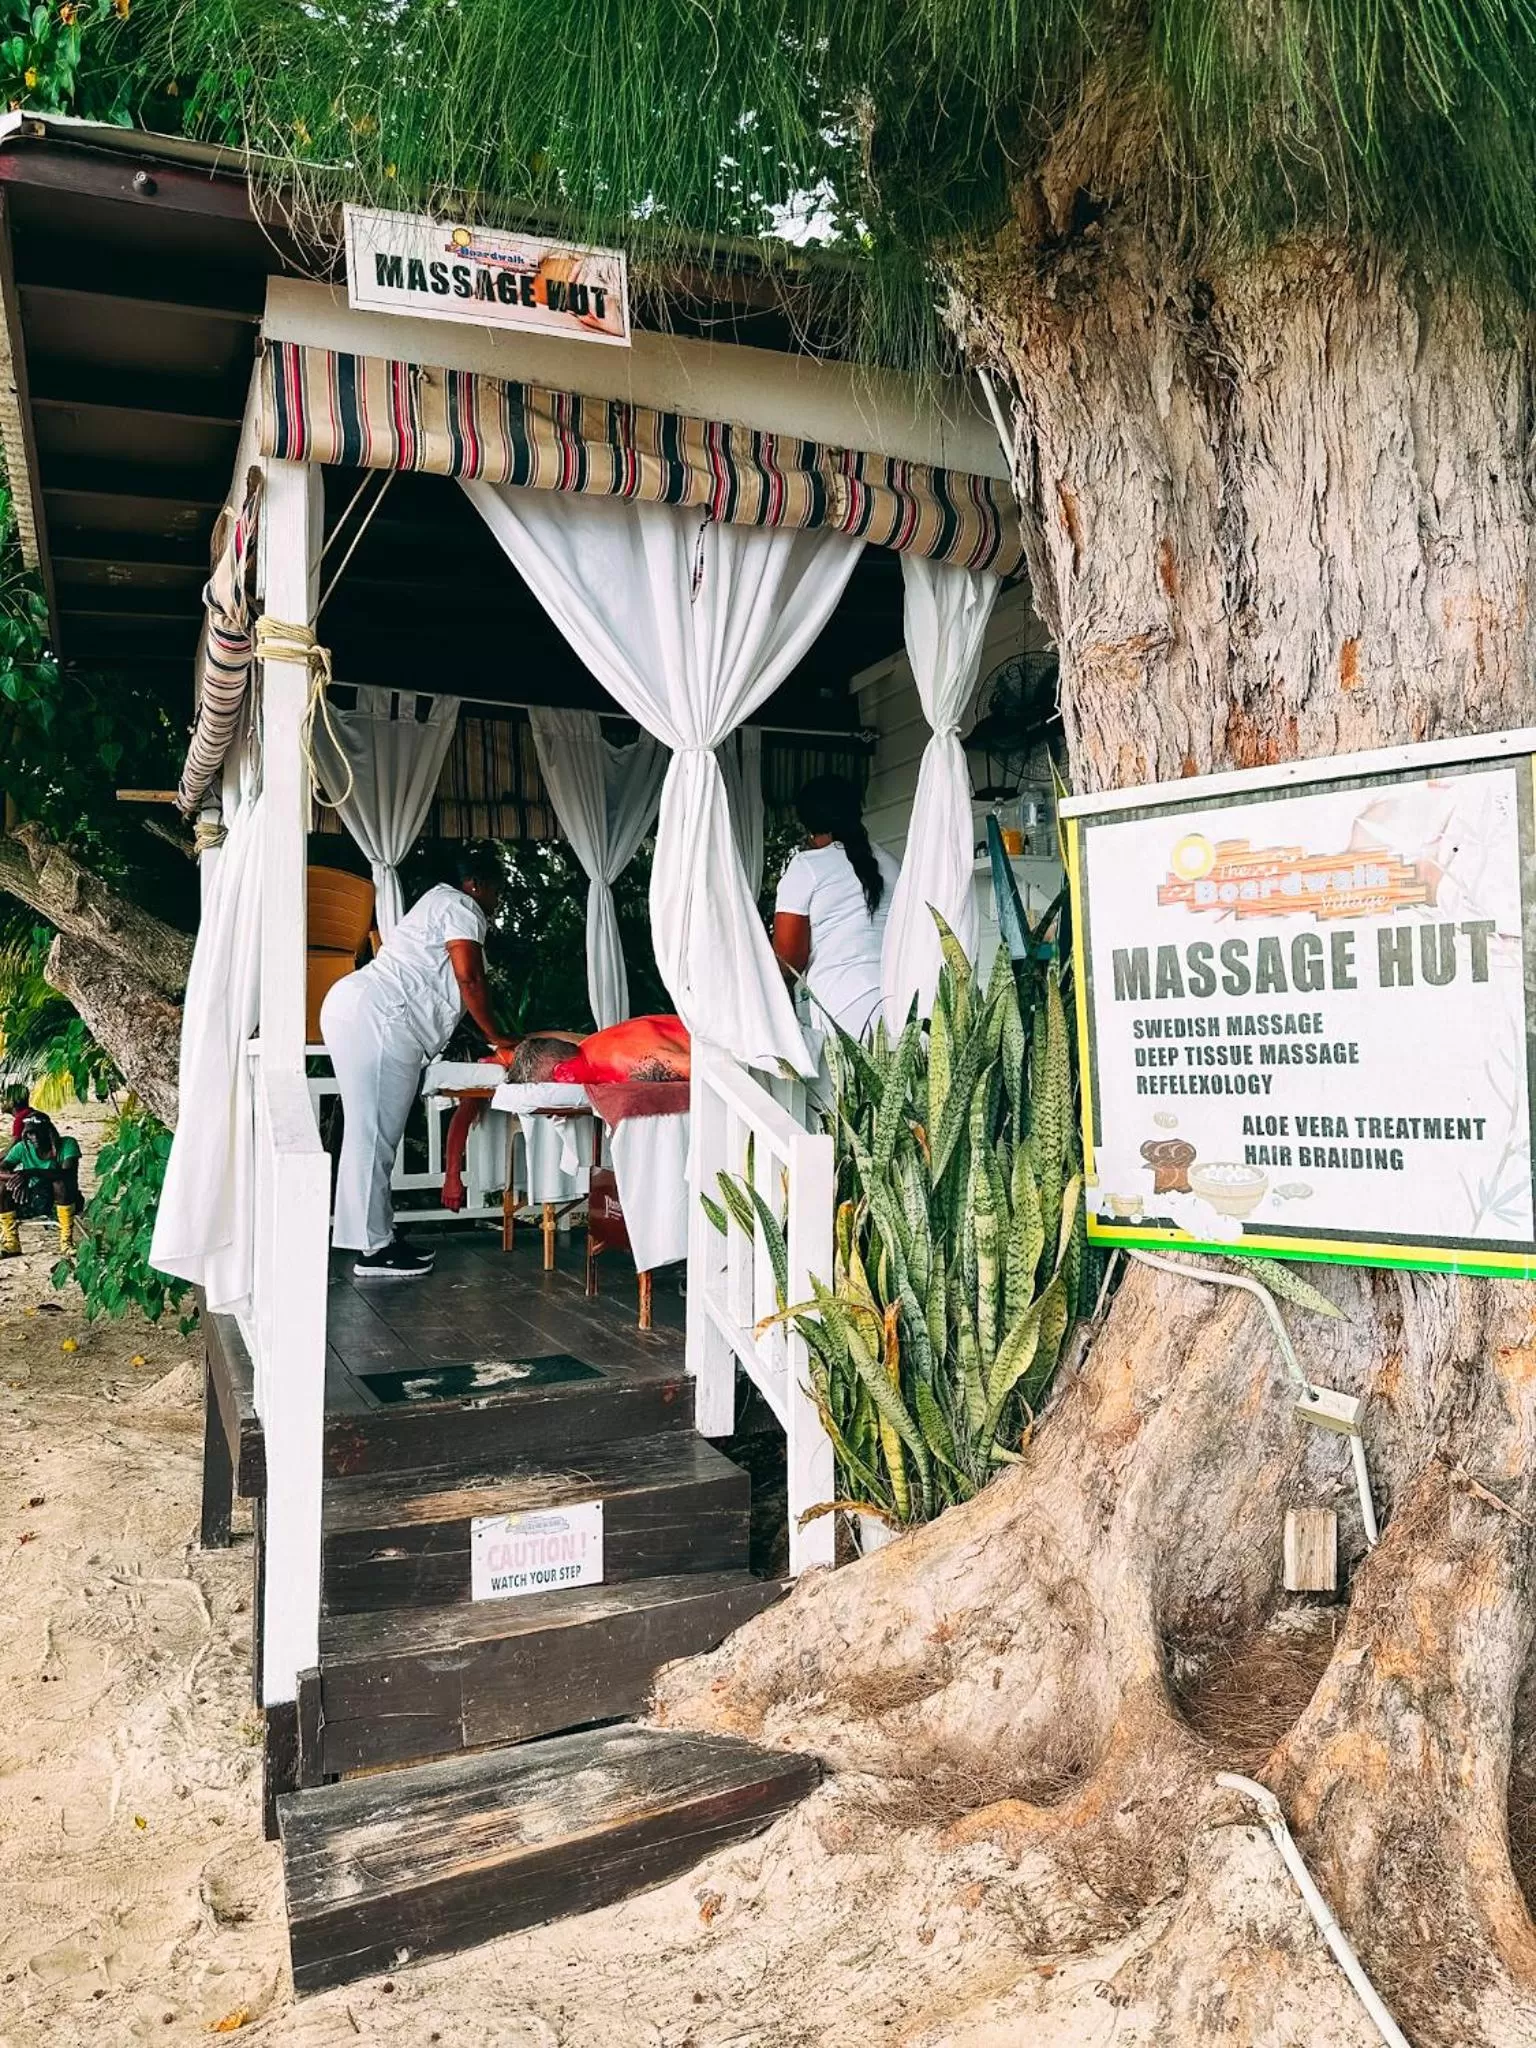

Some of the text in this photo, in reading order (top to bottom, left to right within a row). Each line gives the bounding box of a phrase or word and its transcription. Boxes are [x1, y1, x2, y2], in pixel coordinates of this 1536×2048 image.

[375, 253, 536, 308] MASSAGE
[1194, 863, 1390, 905] Boardwalk
[1112, 919, 1497, 1002] MASSAGE HUT
[1132, 1012, 1324, 1039] SWEDISH MASSAGE
[1135, 1042, 1360, 1067] DEEP TISSUE MASSAGE
[1136, 1074, 1273, 1095] REFELEXOLOGY
[1242, 1115, 1487, 1140] ALOE VERA TREATMENT
[1244, 1144, 1404, 1171] HAIR BRAIDING
[490, 1565, 582, 1591] WATCH YOUR STEP
